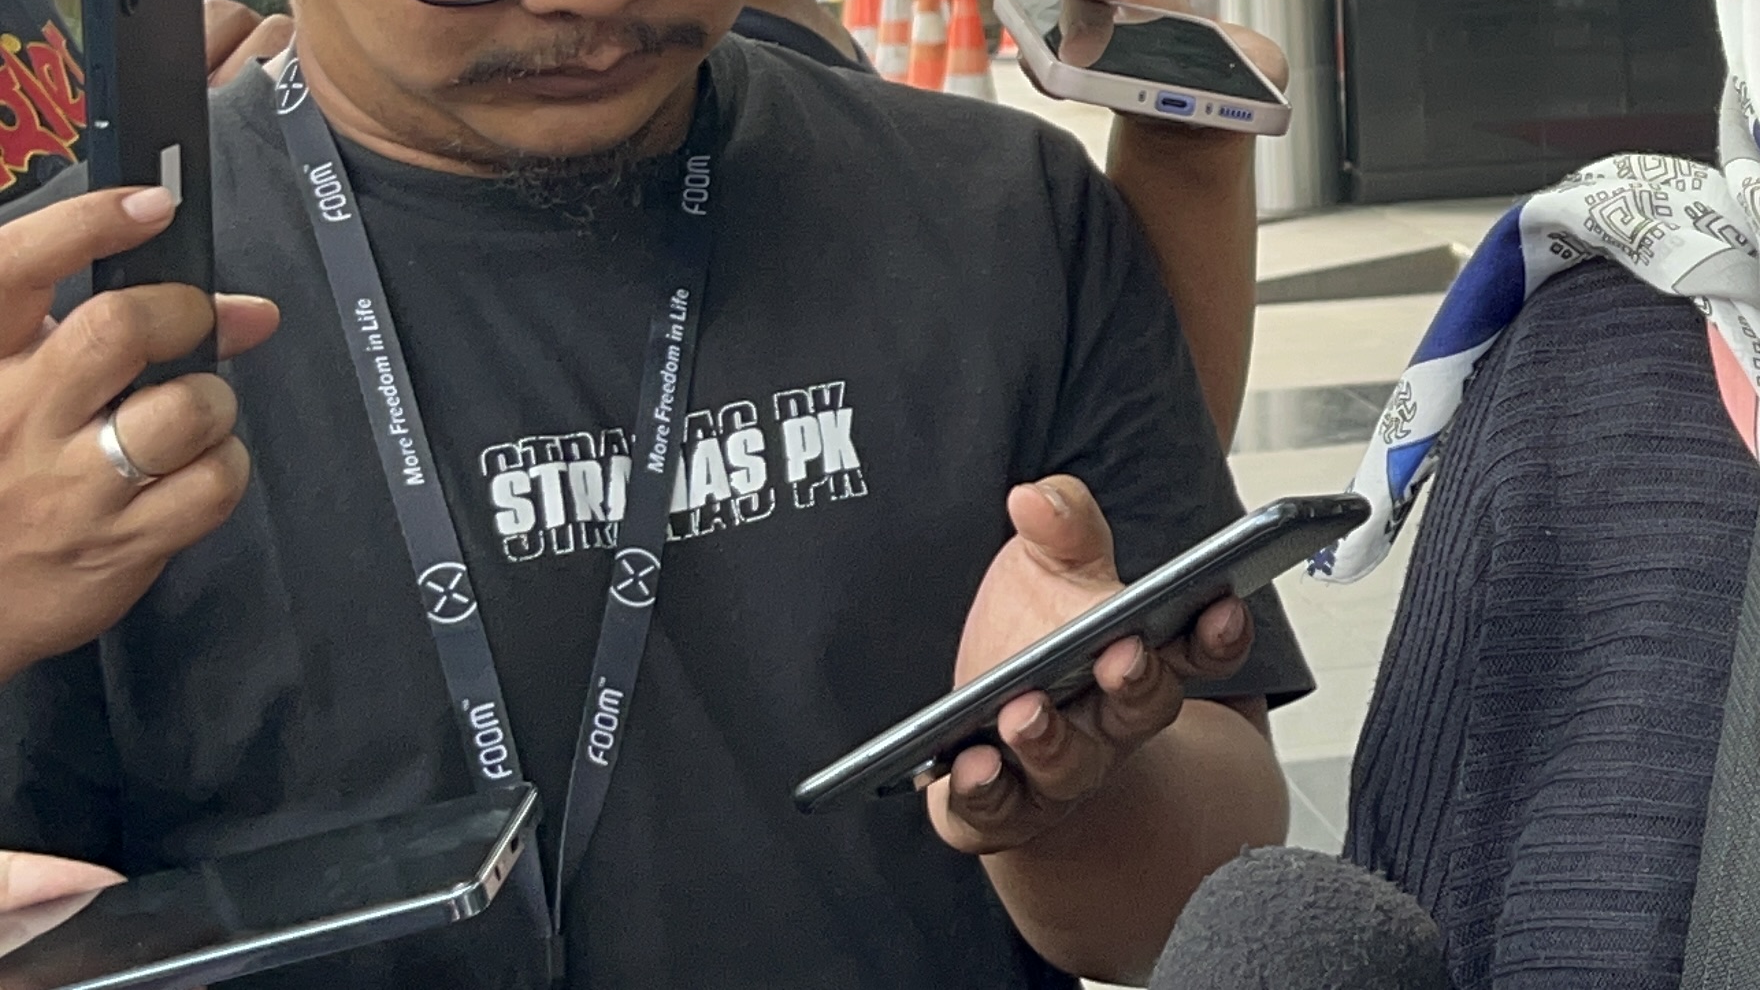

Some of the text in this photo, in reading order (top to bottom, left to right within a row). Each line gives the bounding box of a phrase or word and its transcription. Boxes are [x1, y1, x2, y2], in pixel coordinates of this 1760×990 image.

[355, 298, 425, 486] More Freedom in Life
[647, 288, 689, 474] More Freedom in Life
[781, 407, 862, 484] PK
